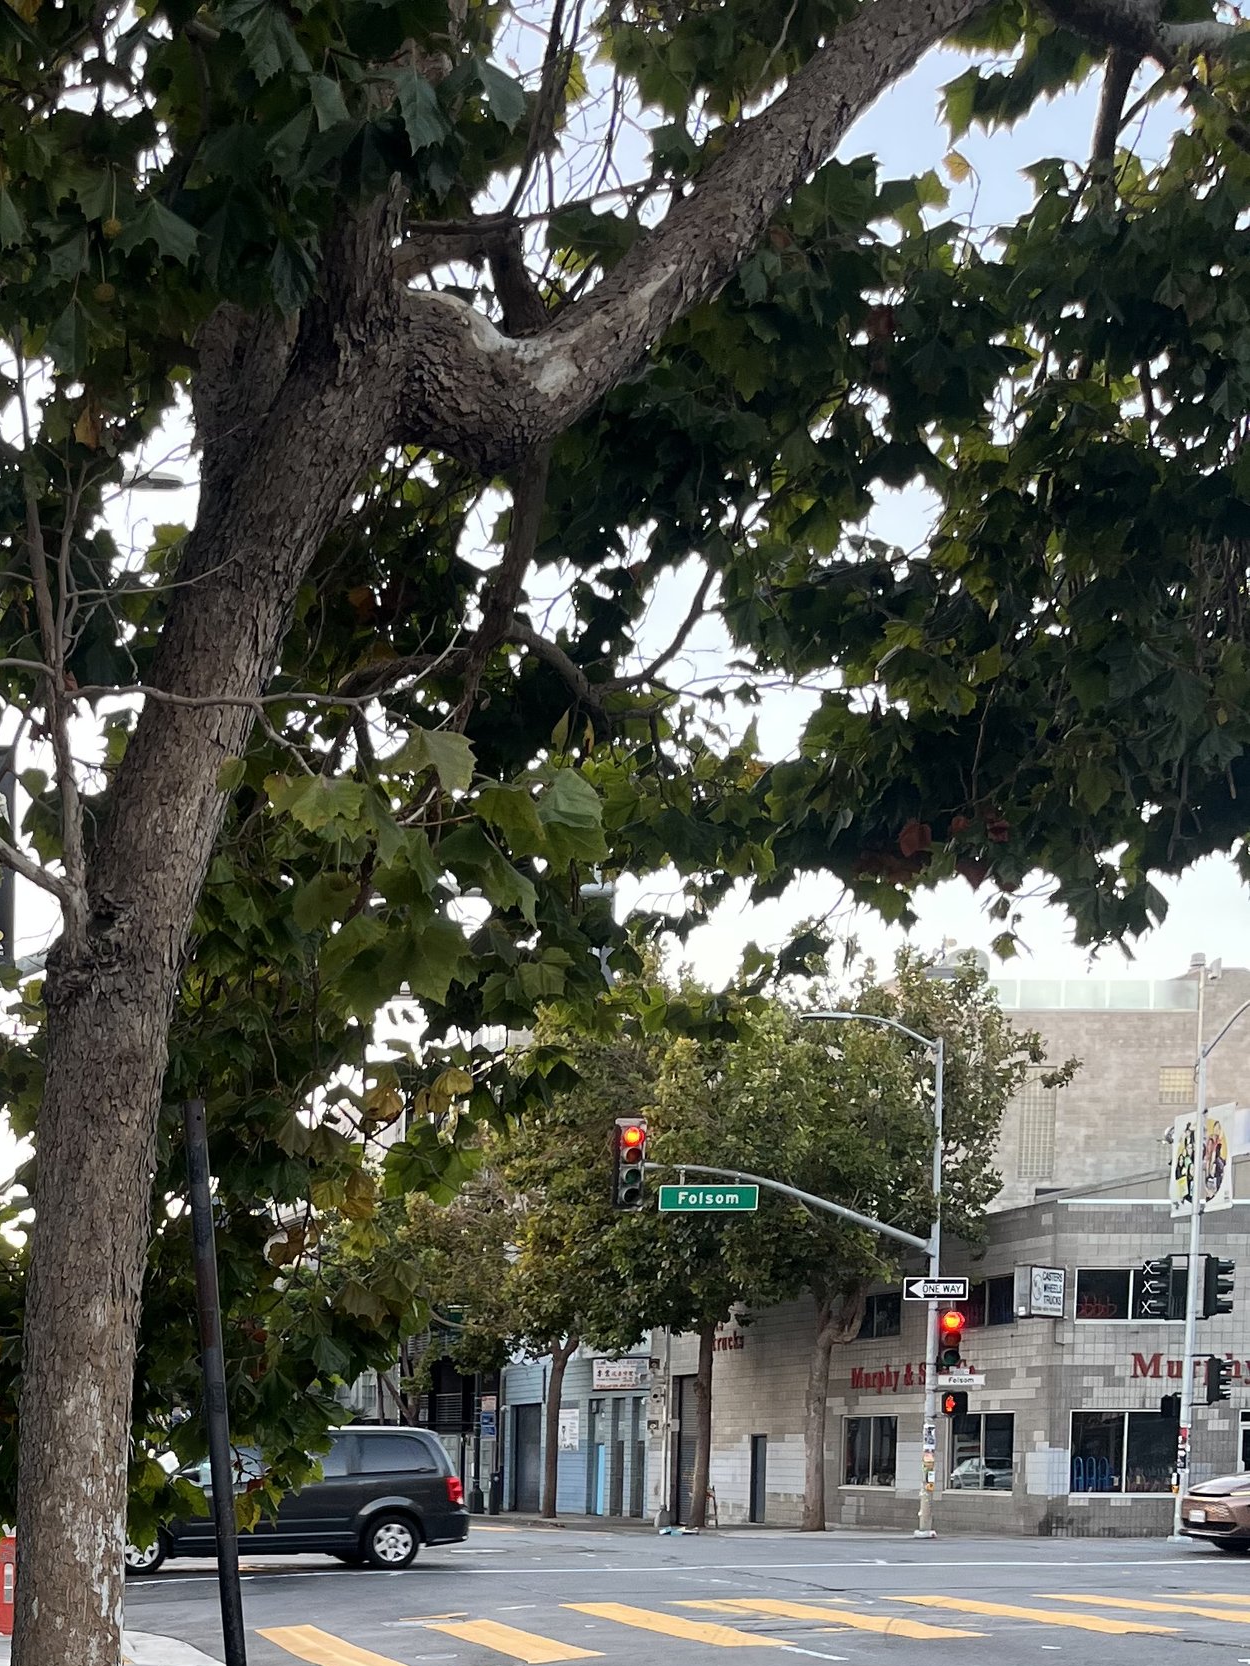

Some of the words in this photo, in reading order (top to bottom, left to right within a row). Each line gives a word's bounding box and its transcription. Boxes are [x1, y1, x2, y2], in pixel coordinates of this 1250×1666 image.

[677, 1190, 740, 1206] Folsom
[1043, 1271, 1063, 1283] CASTERS
[922, 1284, 940, 1294] ONE
[943, 1284, 962, 1294] WAY
[1043, 1282, 1062, 1294] WHEELS
[1043, 1294, 1062, 1306] TRUCKS
[1131, 1352, 1250, 1385] Murh
[850, 1364, 900, 1395] Murphy
[904, 1362, 914, 1386] &
[948, 1376, 975, 1384] Folsom
